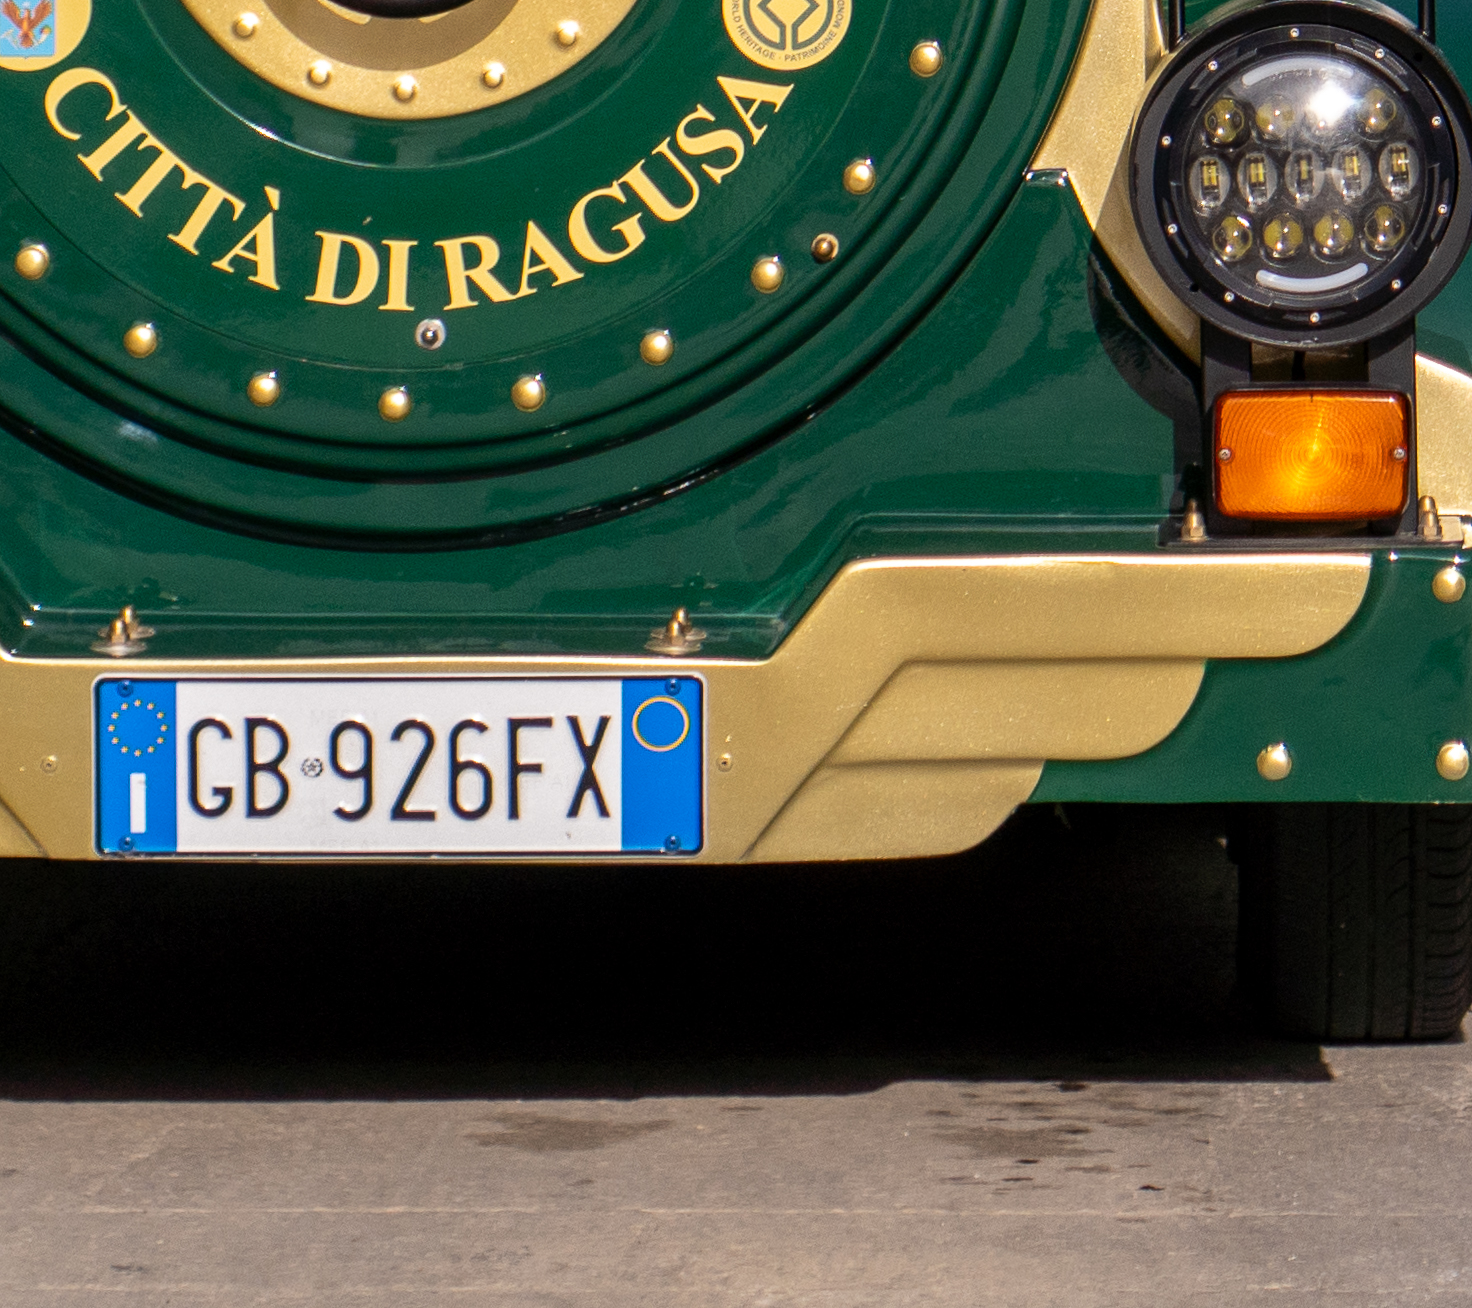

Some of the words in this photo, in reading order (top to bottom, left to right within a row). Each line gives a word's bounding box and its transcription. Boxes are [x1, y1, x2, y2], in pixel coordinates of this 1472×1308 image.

[736, 24, 777, 61] HERITAGE
[784, 30, 837, 63] PATRIMOINE
[44, 67, 280, 291] CITTÀ
[305, 230, 418, 313] DI
[432, 75, 795, 311] RAGUSA
